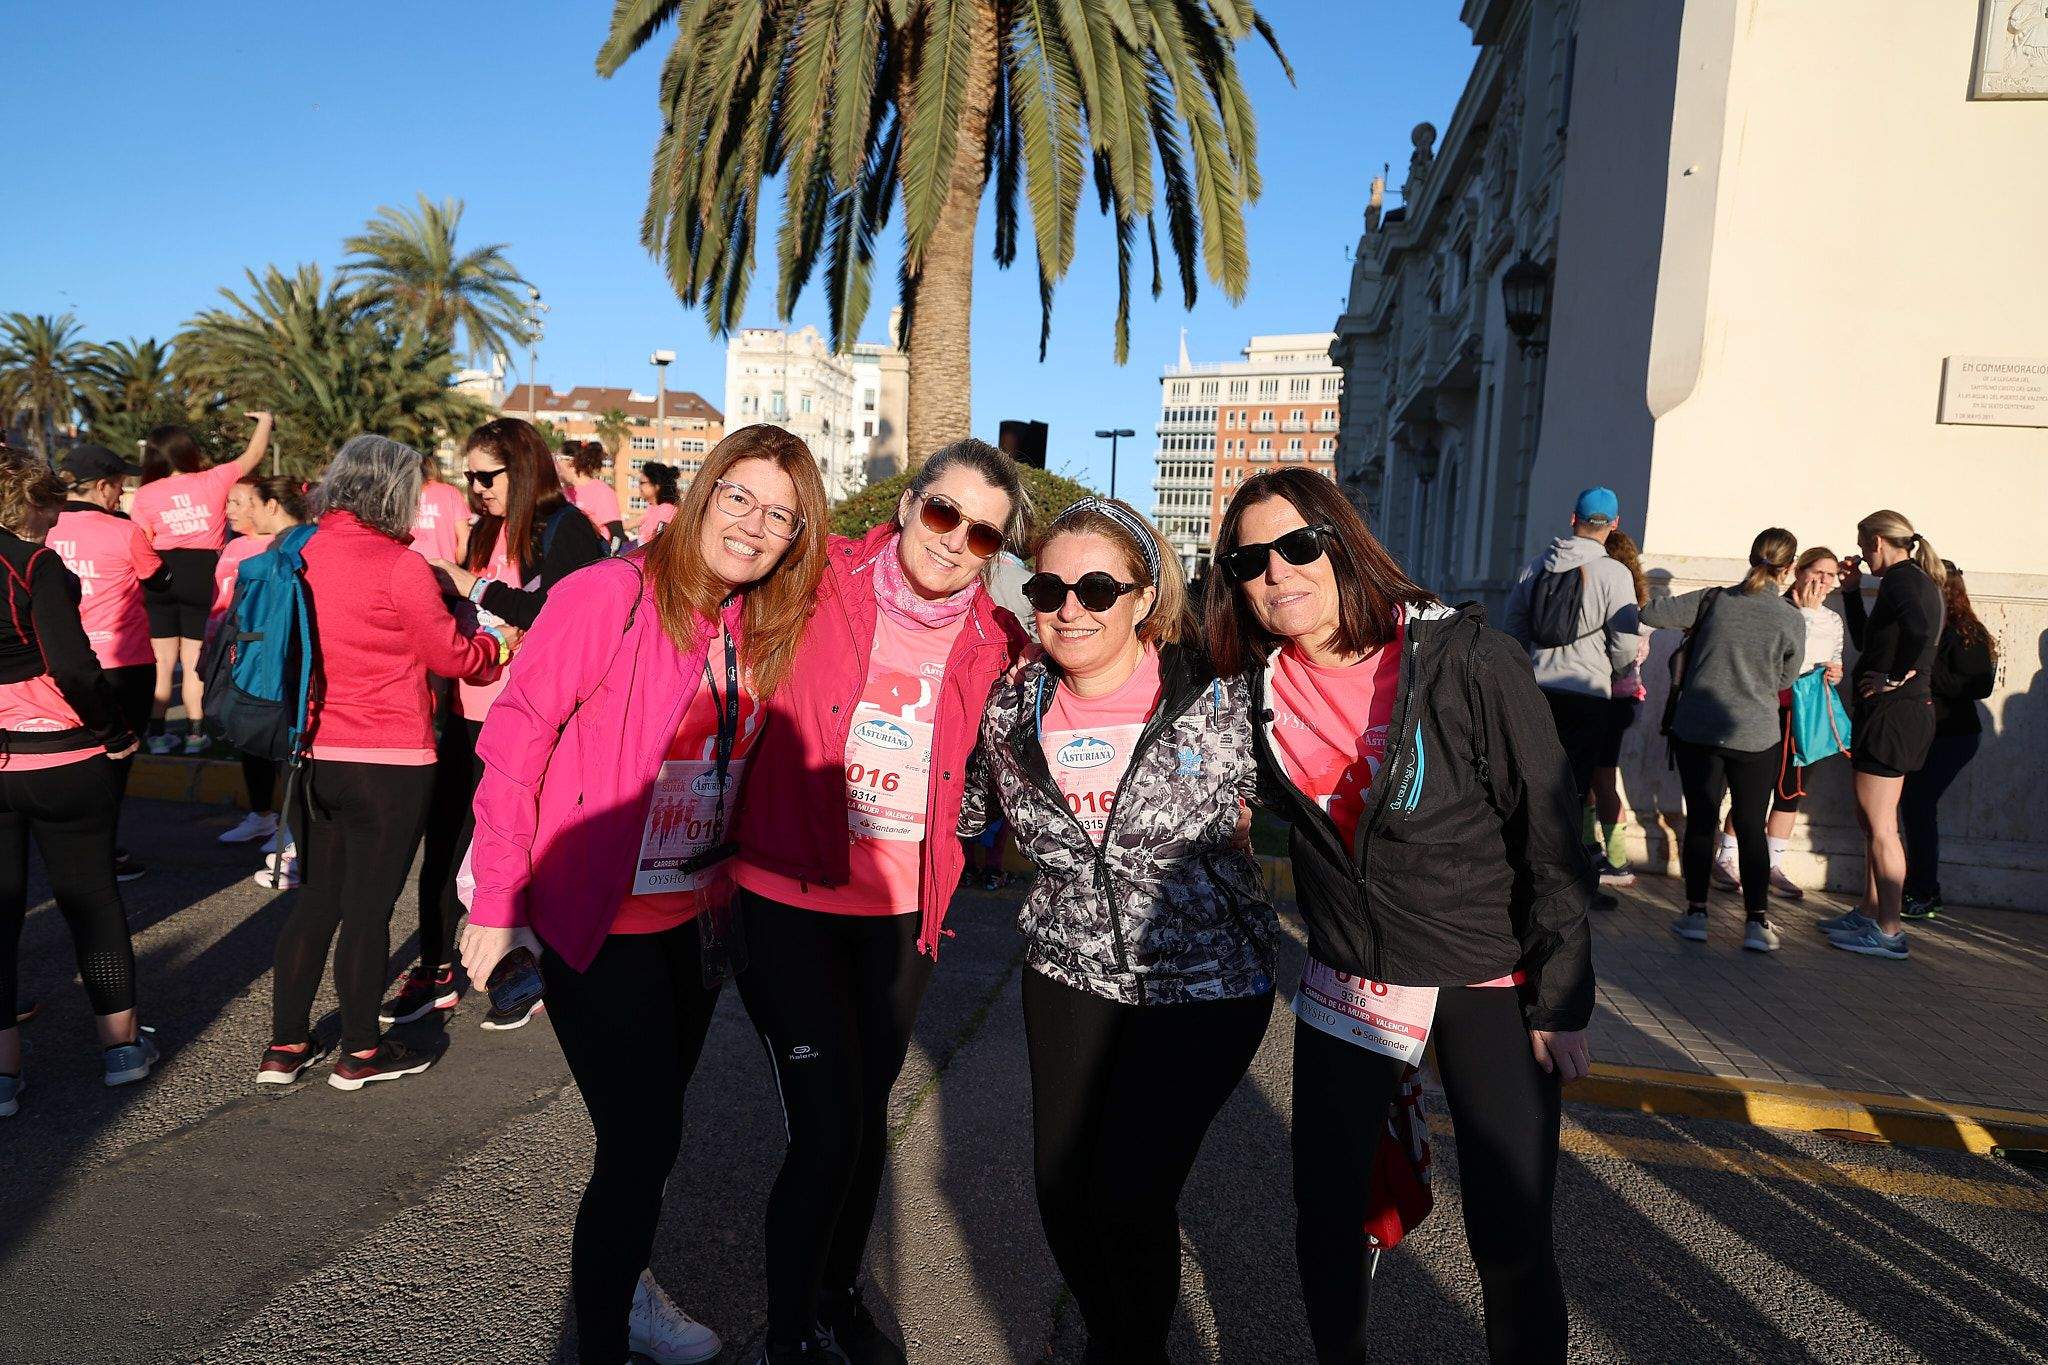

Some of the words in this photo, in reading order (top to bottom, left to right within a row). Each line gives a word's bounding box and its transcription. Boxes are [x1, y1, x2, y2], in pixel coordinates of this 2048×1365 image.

[1962, 363, 1974, 373] EN
[170, 493, 192, 509] TU
[53, 541, 77, 559] TU
[847, 763, 901, 793] 016
[851, 789, 877, 804] 9314
[1065, 790, 1116, 815] 016
[858, 803, 880, 815] MUJER
[885, 810, 915, 821] VALENCIA
[871, 822, 911, 835] Santander
[653, 860, 679, 868] CARRERA
[648, 875, 687, 886] OYSHO
[1341, 990, 1366, 1008] 9316
[1301, 1000, 1335, 1026] OYSHO
[1305, 987, 1328, 1005] CARRERA
[1328, 1000, 1337, 1009] DE
[1338, 1003, 1347, 1012] LA
[1347, 1007, 1370, 1021] MUJER
[1376, 1017, 1409, 1034] VALENCIA
[1363, 1030, 1409, 1051] Santander
